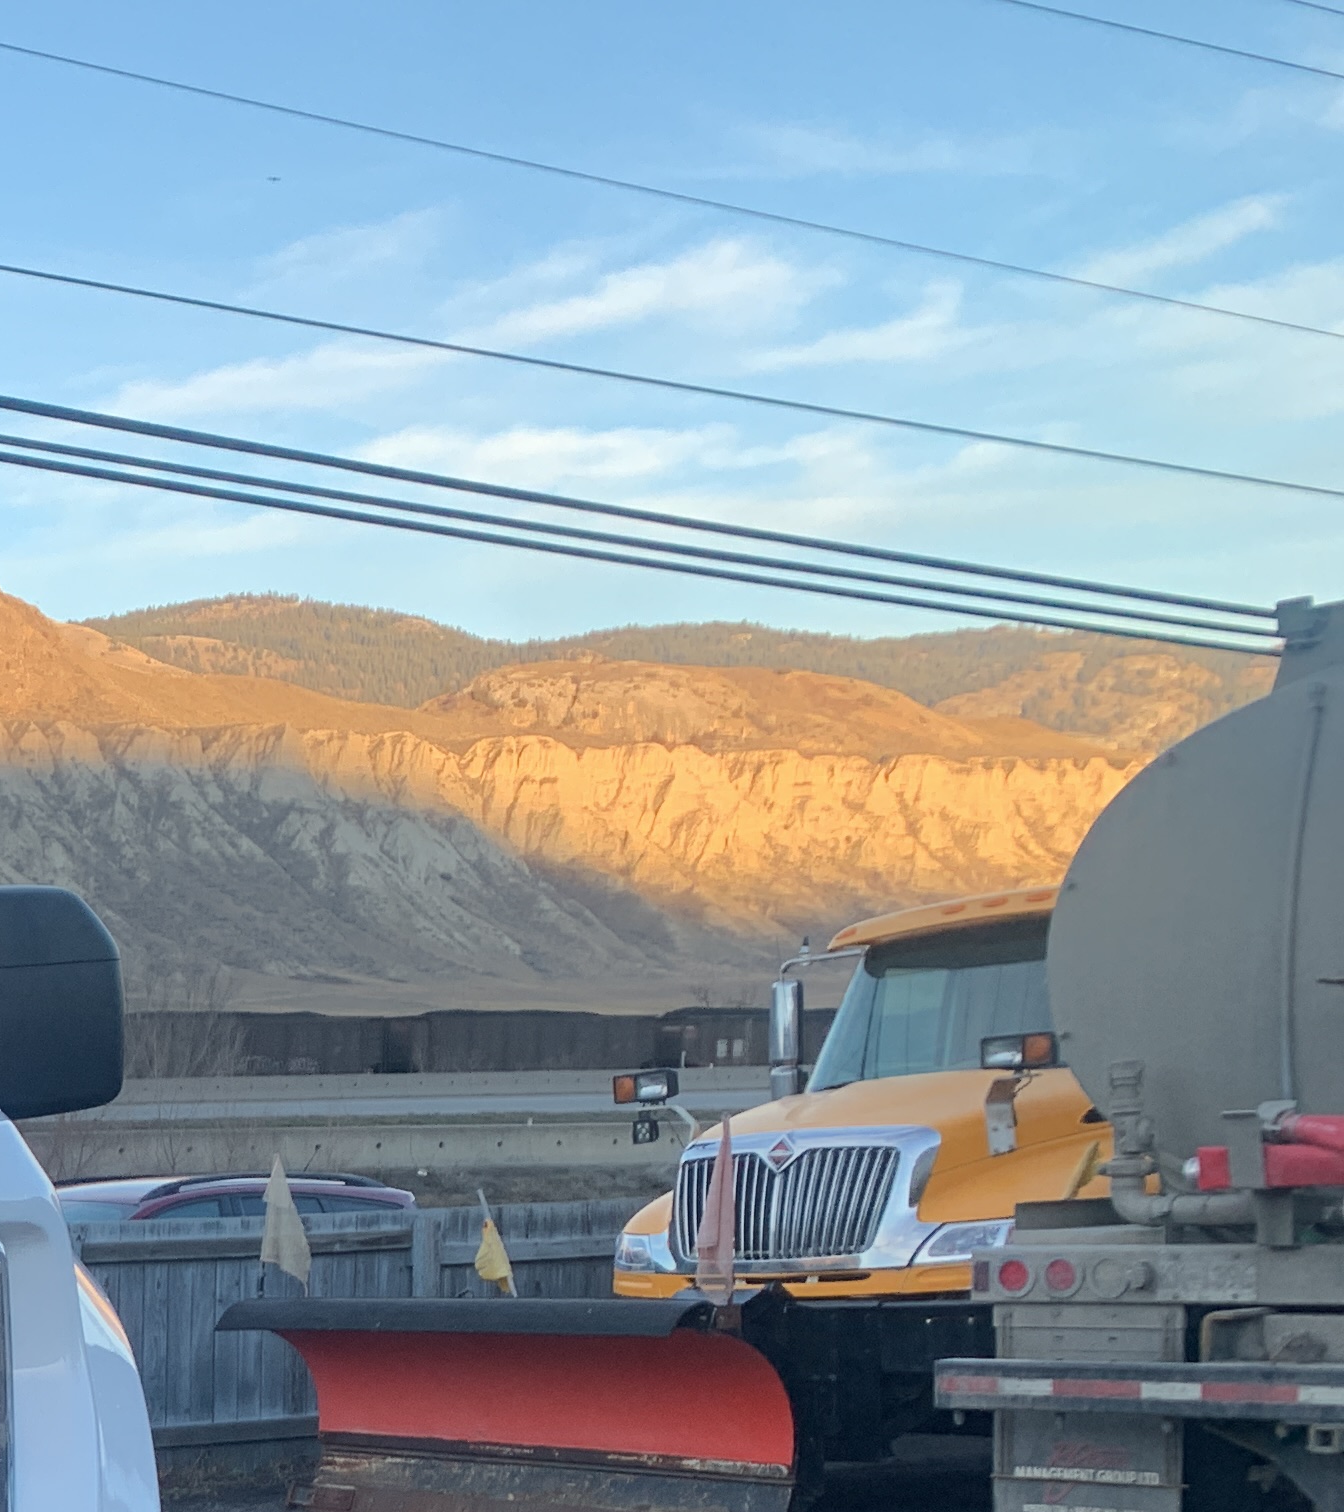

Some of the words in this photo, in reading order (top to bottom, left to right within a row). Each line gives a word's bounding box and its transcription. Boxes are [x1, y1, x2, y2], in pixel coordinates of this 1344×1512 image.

[1013, 1465, 1094, 1481] MANAGEMENT
[1095, 1469, 1137, 1484] GROUP
[1137, 1471, 1160, 1485] LTD
